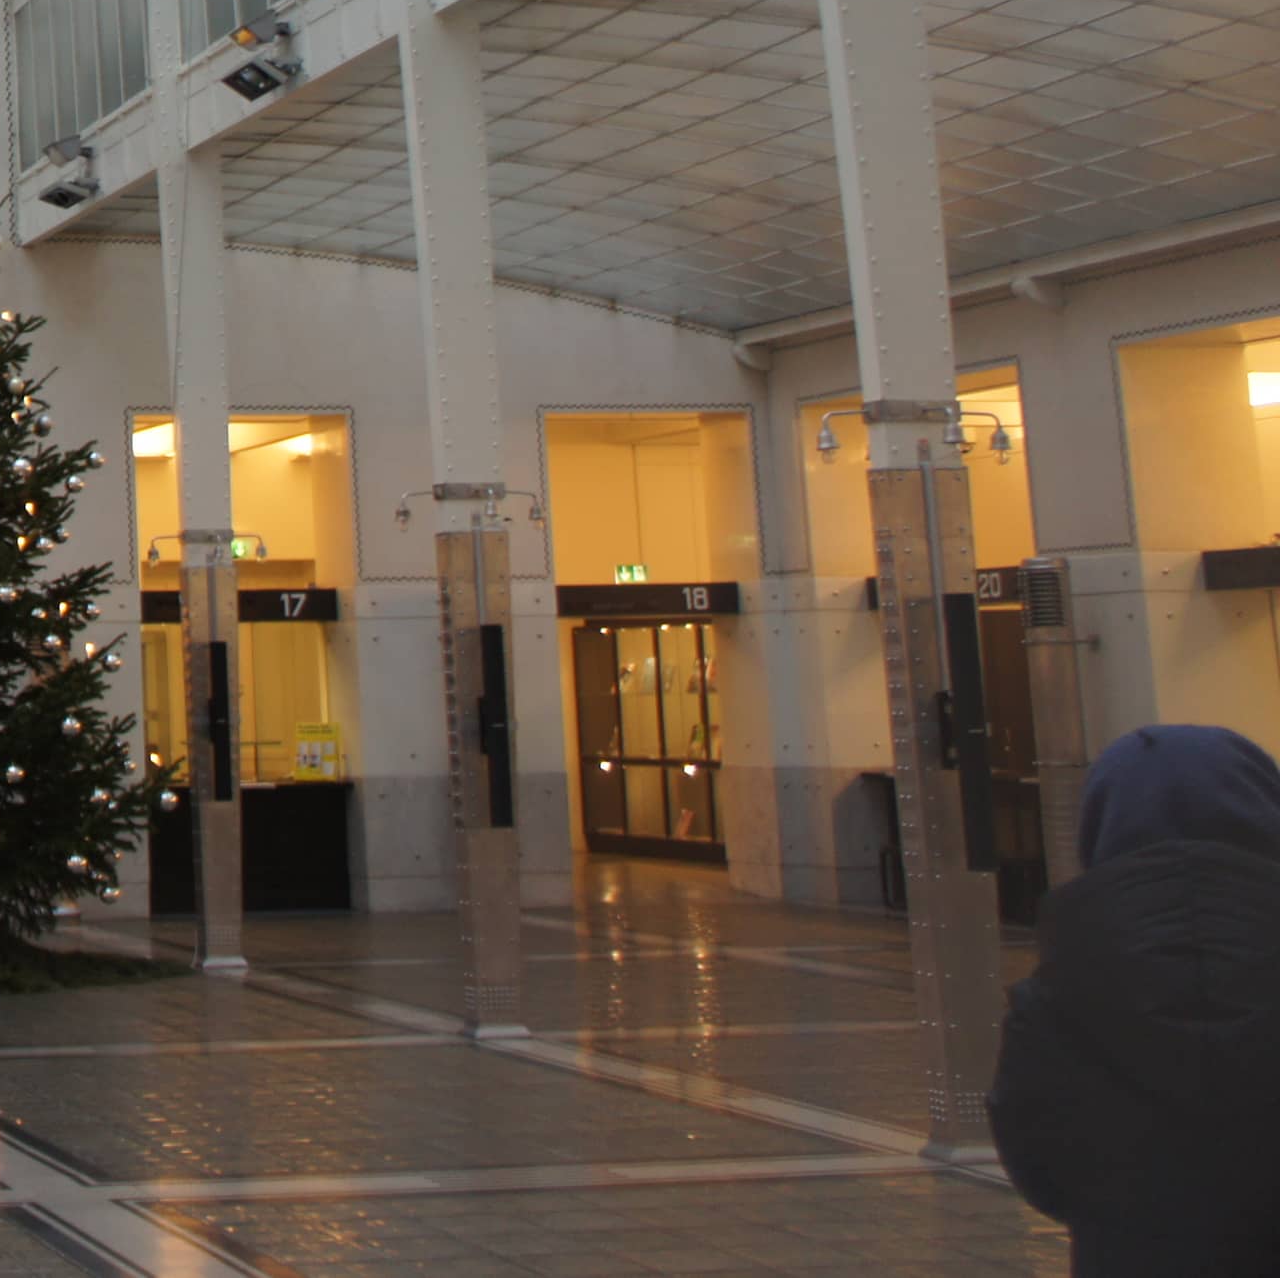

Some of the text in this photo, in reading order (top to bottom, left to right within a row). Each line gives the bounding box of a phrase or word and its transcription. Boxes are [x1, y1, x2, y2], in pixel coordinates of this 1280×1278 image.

[978, 572, 1002, 598] 20
[279, 593, 307, 618] 17
[681, 586, 710, 611] 18
